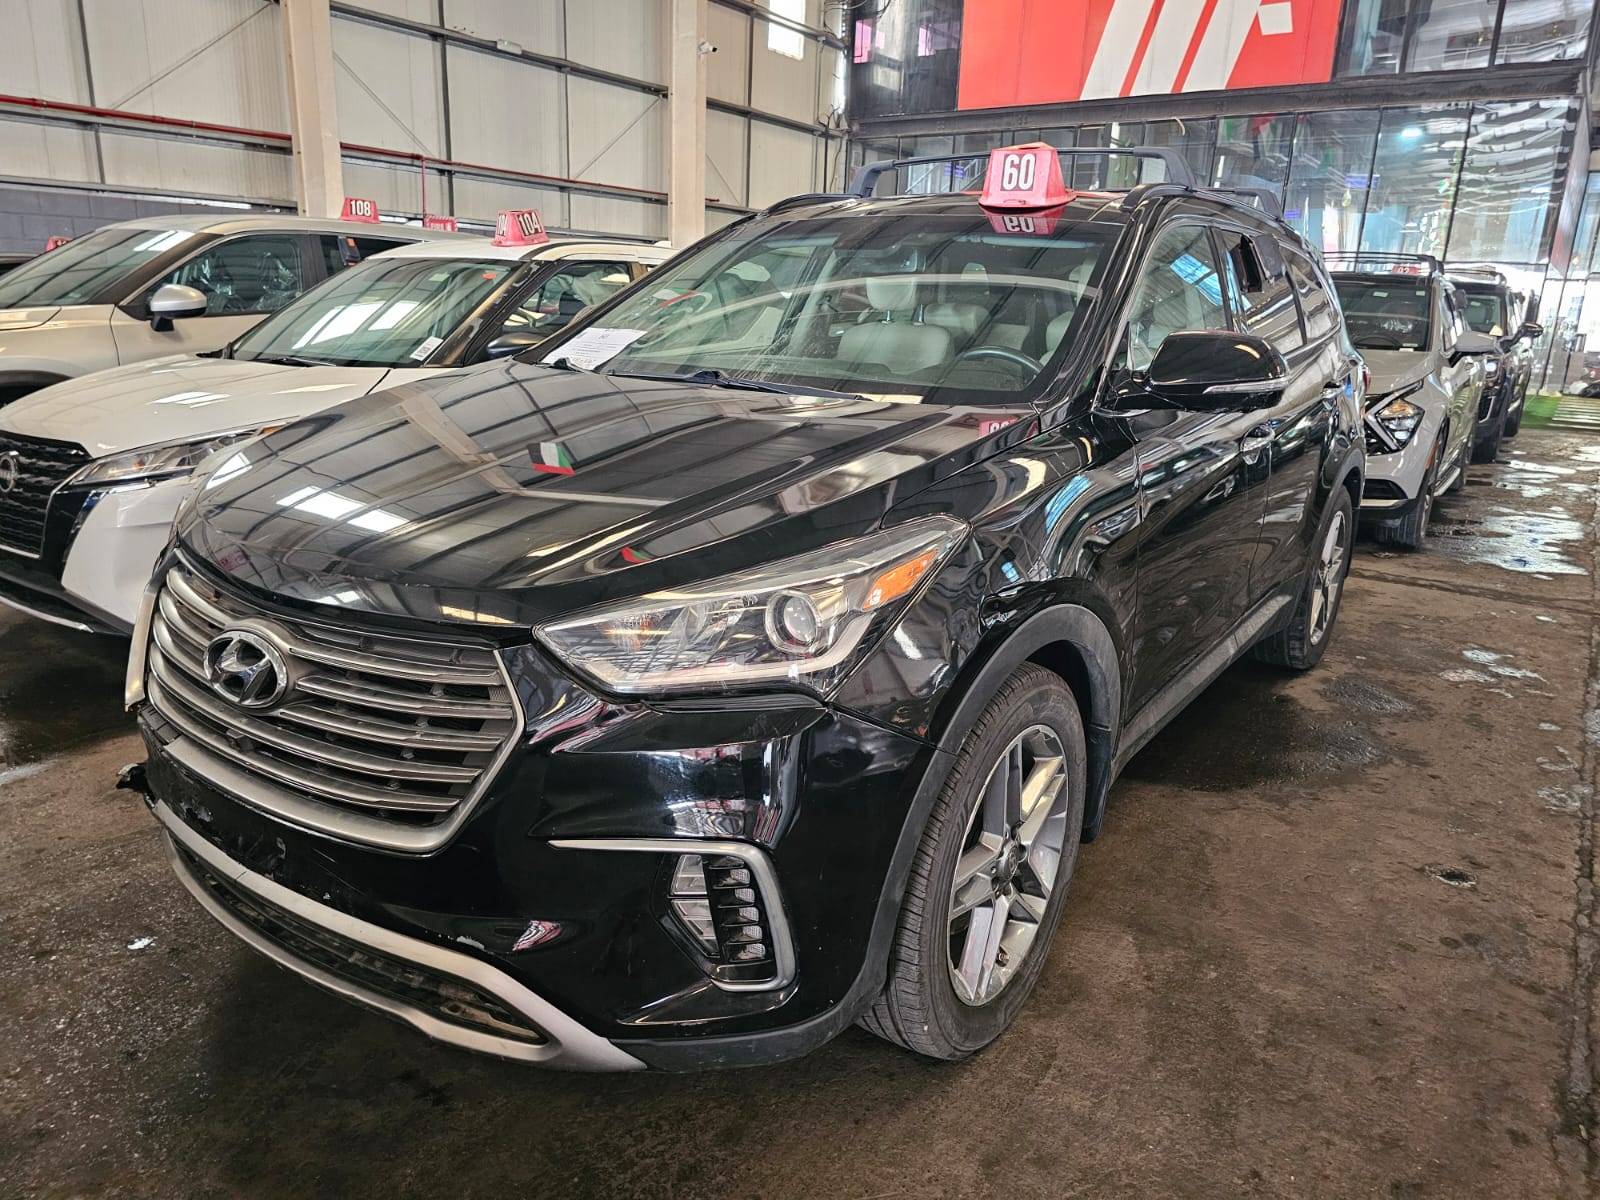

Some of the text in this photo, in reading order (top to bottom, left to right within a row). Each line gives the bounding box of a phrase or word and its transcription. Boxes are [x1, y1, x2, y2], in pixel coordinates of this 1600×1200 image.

[1002, 153, 1036, 191] 60
[350, 200, 372, 216] 108
[518, 211, 542, 236] 104
